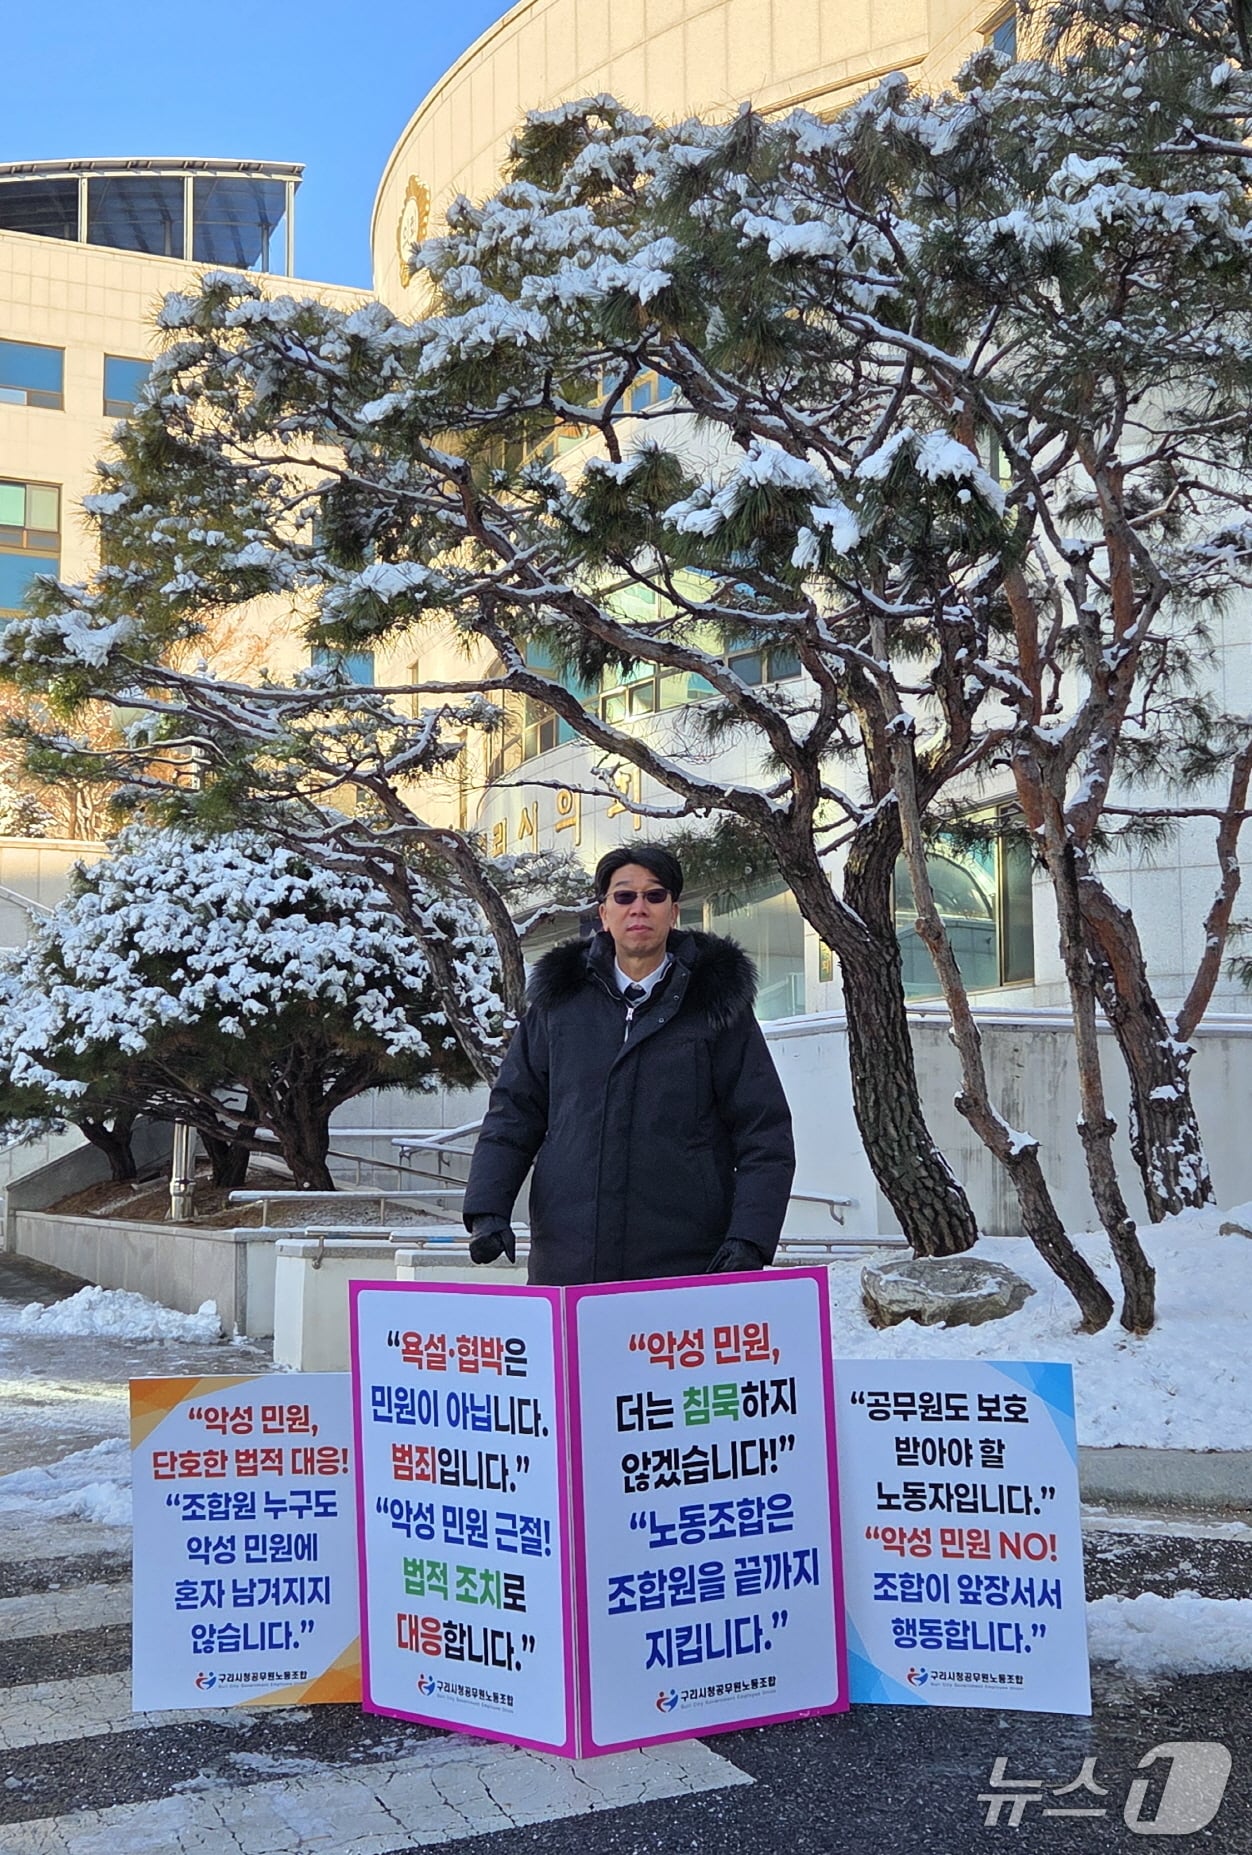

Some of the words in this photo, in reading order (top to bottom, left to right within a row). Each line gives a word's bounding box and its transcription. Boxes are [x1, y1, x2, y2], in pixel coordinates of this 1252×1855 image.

[630, 1329, 704, 1370] “악성
[714, 1323, 779, 1365] 민원,
[189, 1406, 252, 1435] “악성
[262, 1405, 317, 1437] 민원,
[372, 1386, 439, 1427] 민원이
[447, 1392, 548, 1437] 아닙니다.
[617, 1392, 674, 1432] 더는
[683, 1377, 796, 1426] 침묵하지
[851, 1391, 970, 1422] “공무원도
[977, 1394, 1029, 1423] 보호
[153, 1449, 228, 1480] 단호한
[235, 1448, 283, 1477] 법적
[292, 1447, 348, 1475] 대응!
[392, 1443, 529, 1493] 범죄입니다.”
[622, 1434, 795, 1493] 않겠습니다!”
[895, 1437, 973, 1467] 받아야
[979, 1438, 1005, 1469] 할
[166, 1491, 256, 1521] “조합원
[264, 1490, 337, 1520] 누구도
[877, 1481, 1055, 1515] 노동자입니다.”
[376, 1497, 435, 1540] “악성
[442, 1505, 488, 1549] 민원
[495, 1512, 551, 1557] 근절!
[630, 1494, 793, 1548] “노동조합은
[187, 1535, 236, 1565] 악성
[245, 1533, 317, 1563] 민원에
[866, 1526, 932, 1557] “악성
[940, 1528, 991, 1559] 민원
[1000, 1532, 1057, 1561] NO!
[175, 1579, 225, 1610] 혼자
[232, 1576, 330, 1607] 남겨지지
[404, 1558, 448, 1600] 법적
[456, 1566, 526, 1612] 조치로
[608, 1561, 725, 1615] 조합원을
[734, 1548, 819, 1596] 끝까지
[874, 1572, 949, 1604] 조합이
[957, 1574, 1061, 1609] 앞장서서
[192, 1620, 314, 1654] 않습니다.”
[398, 1613, 535, 1671] 대응합니다.”
[646, 1610, 788, 1669] 지킵니다.”
[891, 1618, 1046, 1653] 행동합니다.”
